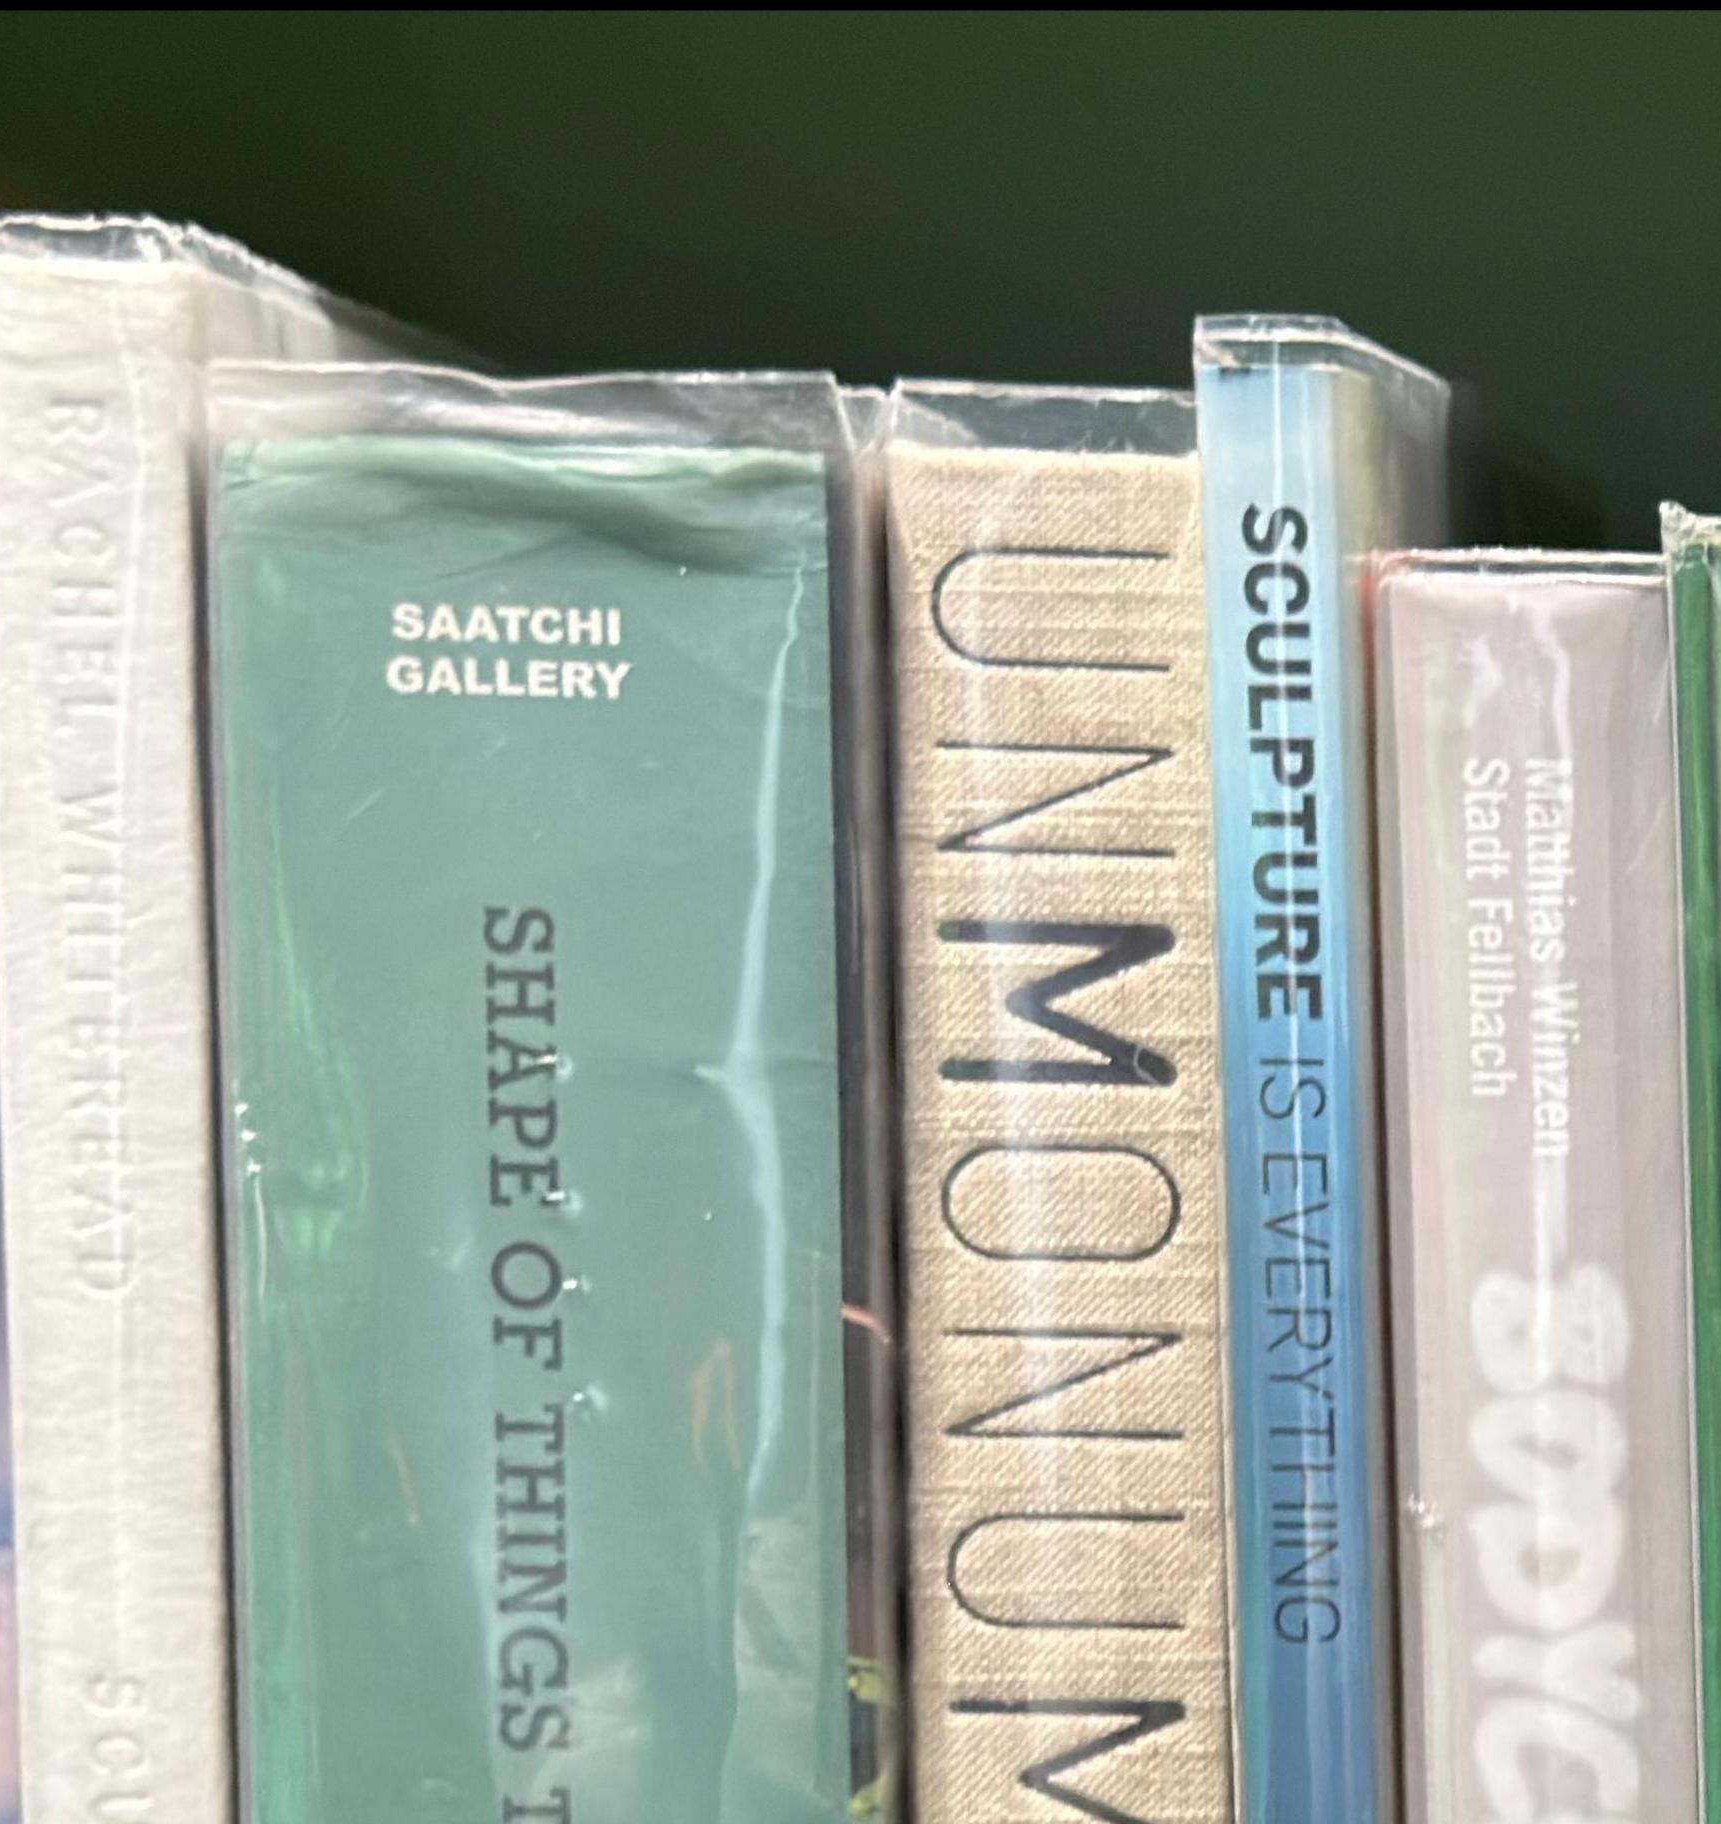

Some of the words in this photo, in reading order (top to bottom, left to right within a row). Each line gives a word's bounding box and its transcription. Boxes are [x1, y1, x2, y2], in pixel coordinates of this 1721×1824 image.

[41, 397, 121, 740] RACHEL
[390, 602, 622, 647] SAATCHI
[384, 657, 632, 700] GALLERY
[1239, 502, 1324, 1024] SCULPTURE
[1462, 756, 1513, 881] Stadt
[1525, 756, 1579, 965] Matthias
[482, 904, 565, 1209] SHAPE
[1258, 1057, 1329, 1123] IS
[1466, 894, 1520, 1101] Fellbach
[1533, 980, 1582, 1160] Winzen
[489, 1240, 565, 1373] OF
[1260, 1151, 1343, 1647] EVERYTHING
[494, 1411, 571, 1754] THINGS
